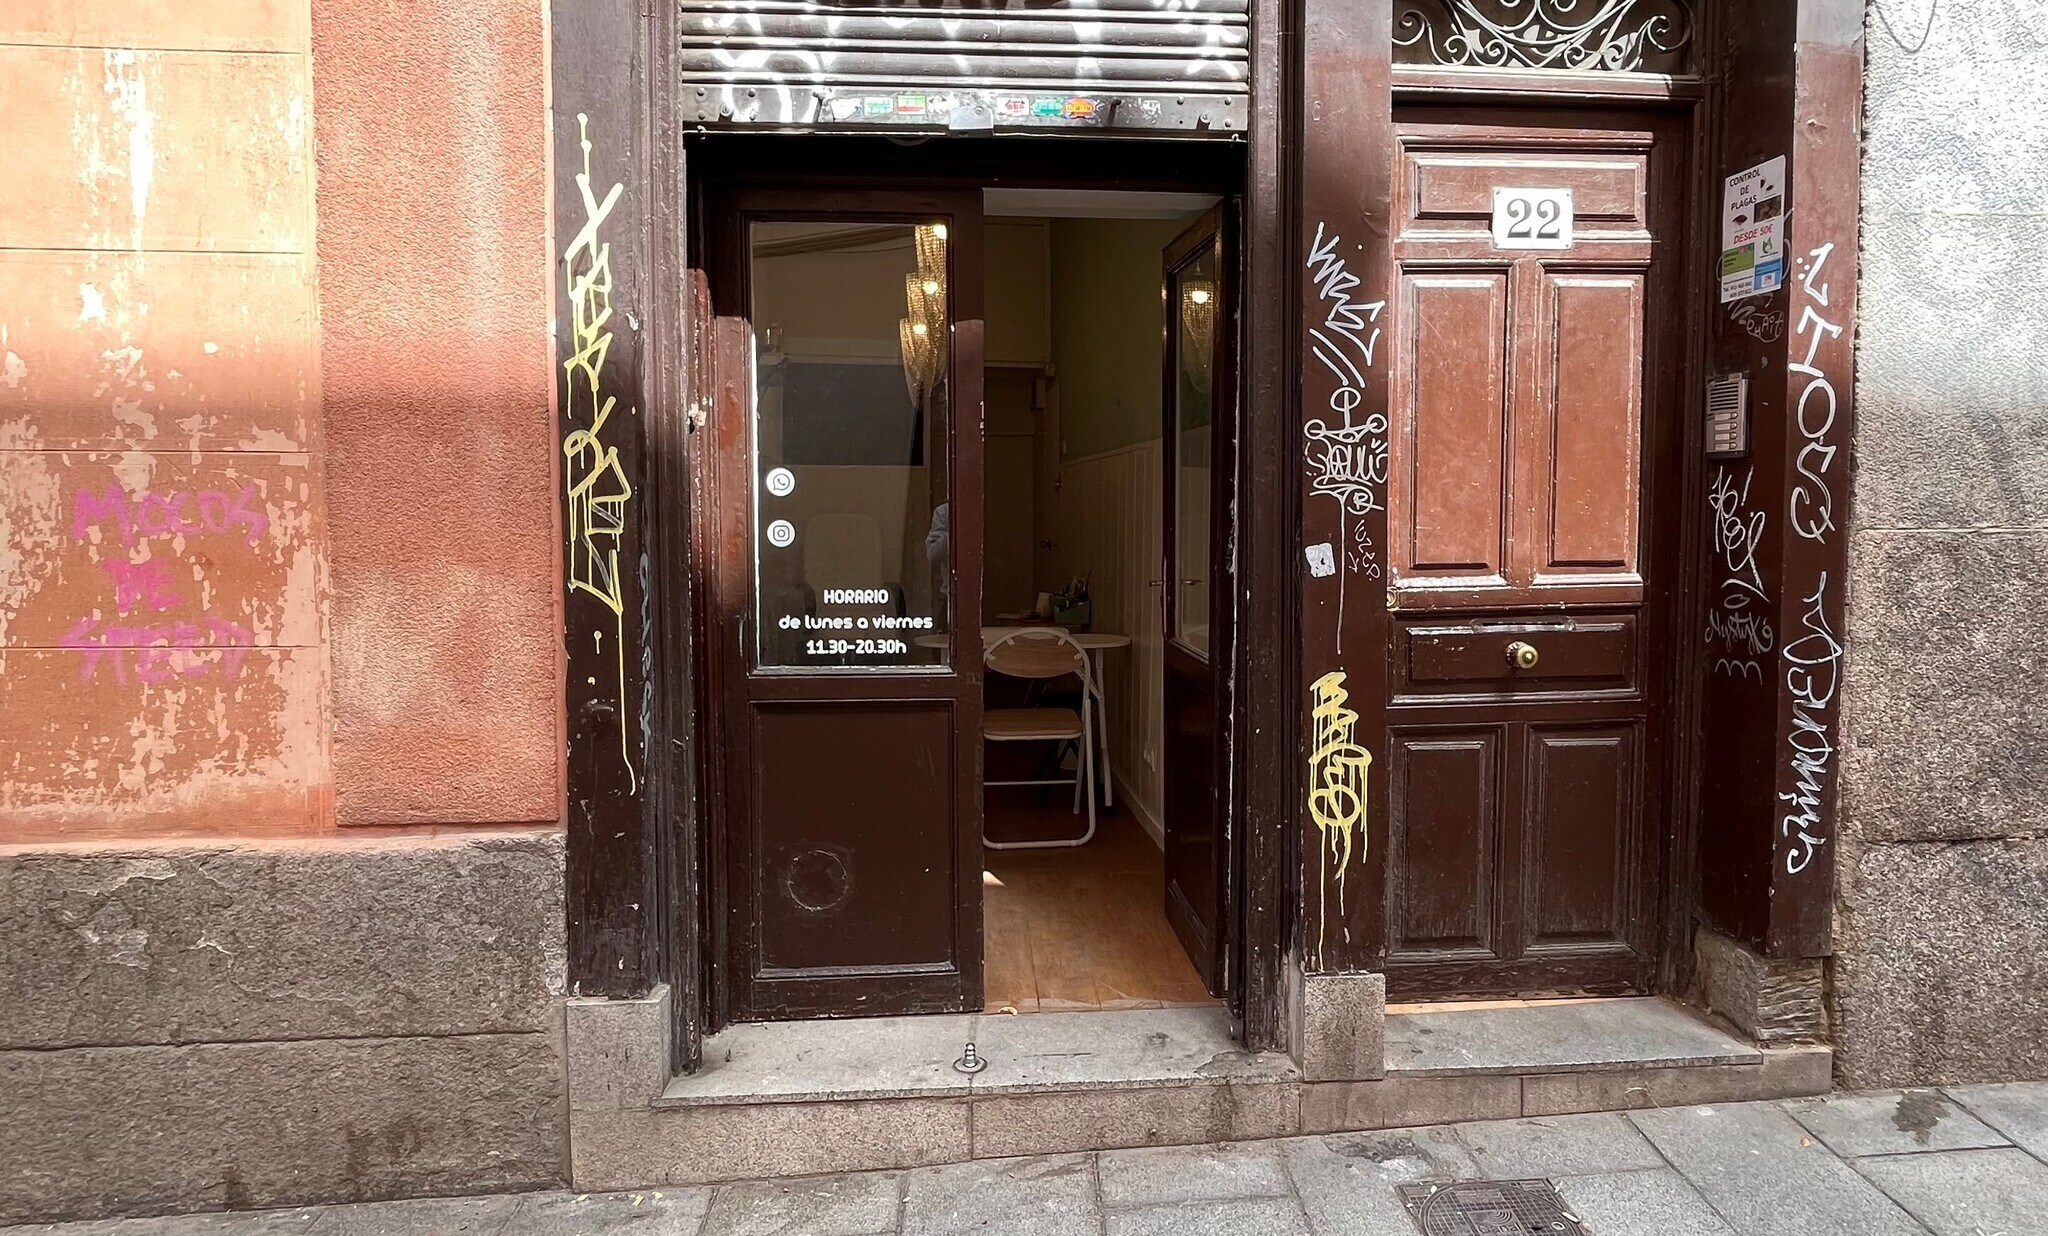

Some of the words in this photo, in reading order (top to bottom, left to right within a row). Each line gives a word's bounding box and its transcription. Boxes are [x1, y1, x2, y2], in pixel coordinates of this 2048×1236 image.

[1729, 168, 1761, 187] CONTROL
[1740, 185, 1750, 196] DE
[1731, 195, 1757, 211] PLAGAS
[1506, 198, 1560, 239] 22
[1733, 228, 1758, 245] DESDE
[823, 589, 889, 604] HORARIO
[778, 614, 802, 629] de
[804, 614, 853, 629] lunes
[856, 617, 869, 629] a
[872, 614, 934, 629] viernes
[806, 639, 907, 654] 11.30-20.30h
